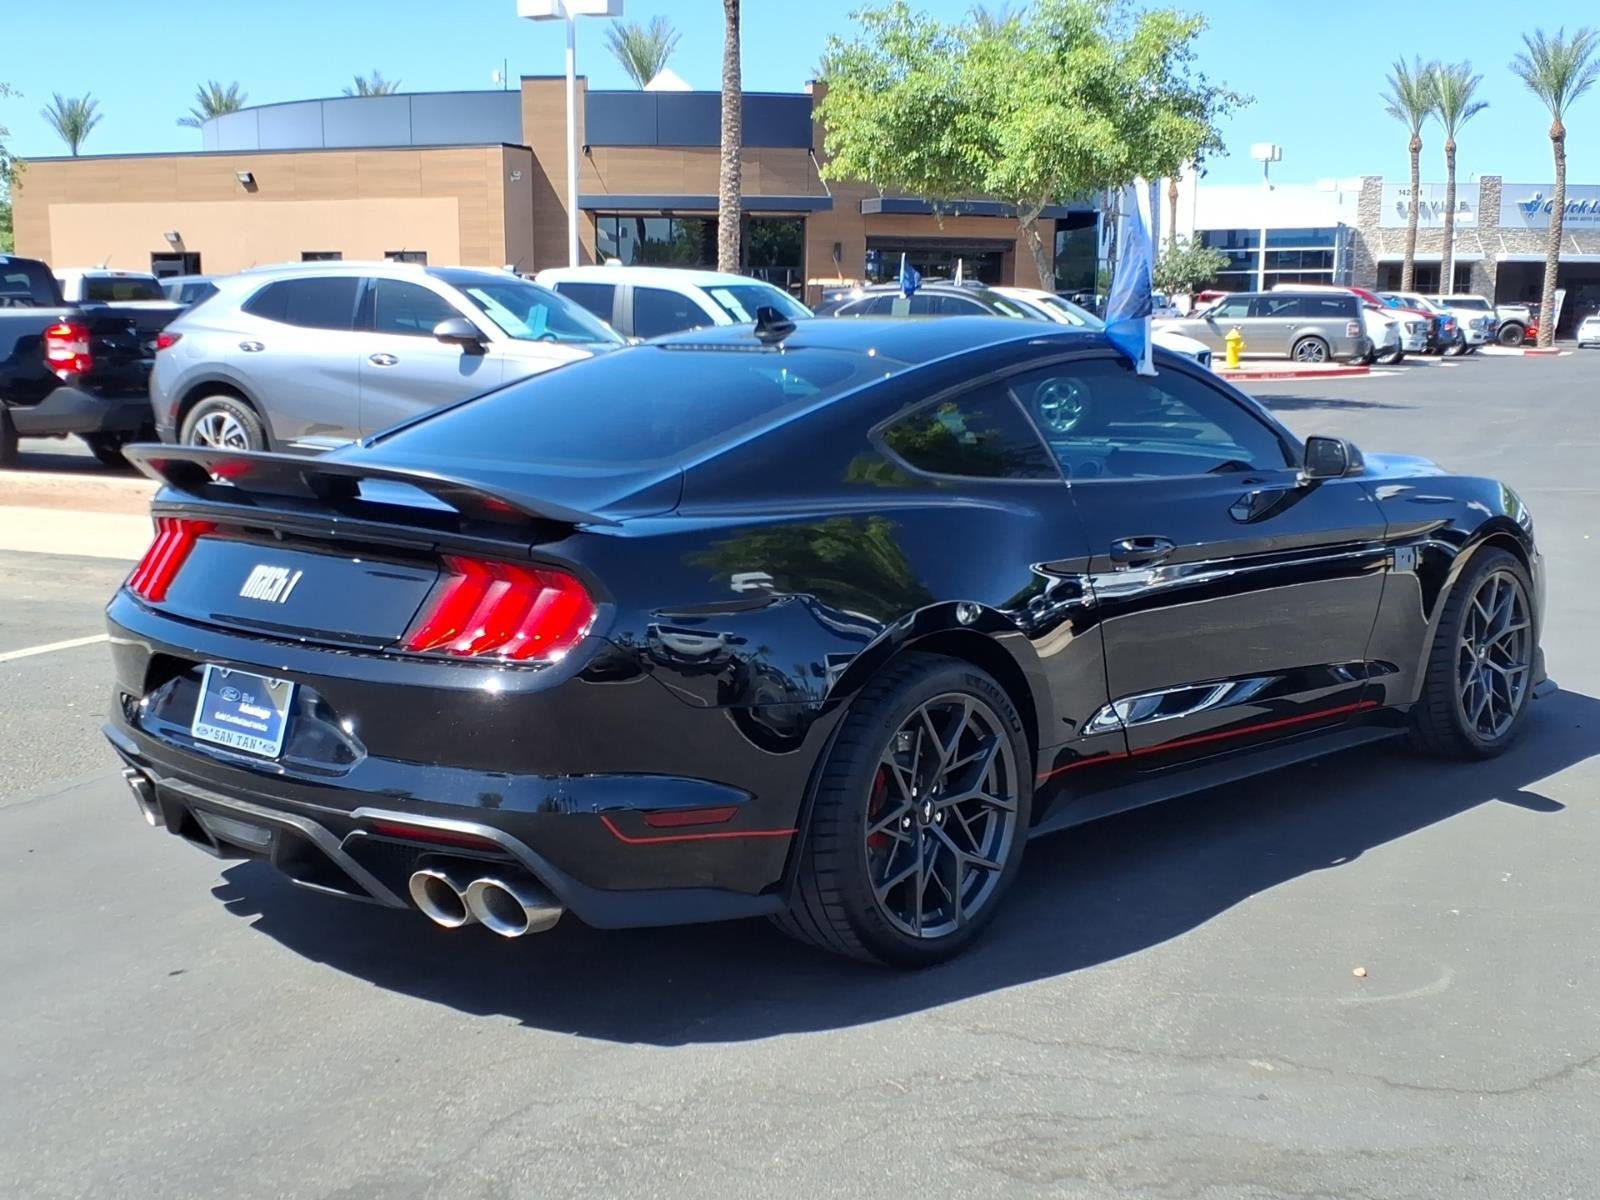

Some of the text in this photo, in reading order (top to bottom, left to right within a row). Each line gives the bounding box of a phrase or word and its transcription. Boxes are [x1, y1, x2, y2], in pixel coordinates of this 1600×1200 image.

[1396, 201, 1467, 210] SRVIE
[1543, 200, 1600, 214] Qick L
[214, 729, 234, 743] SAN
[236, 735, 258, 749] TAN
